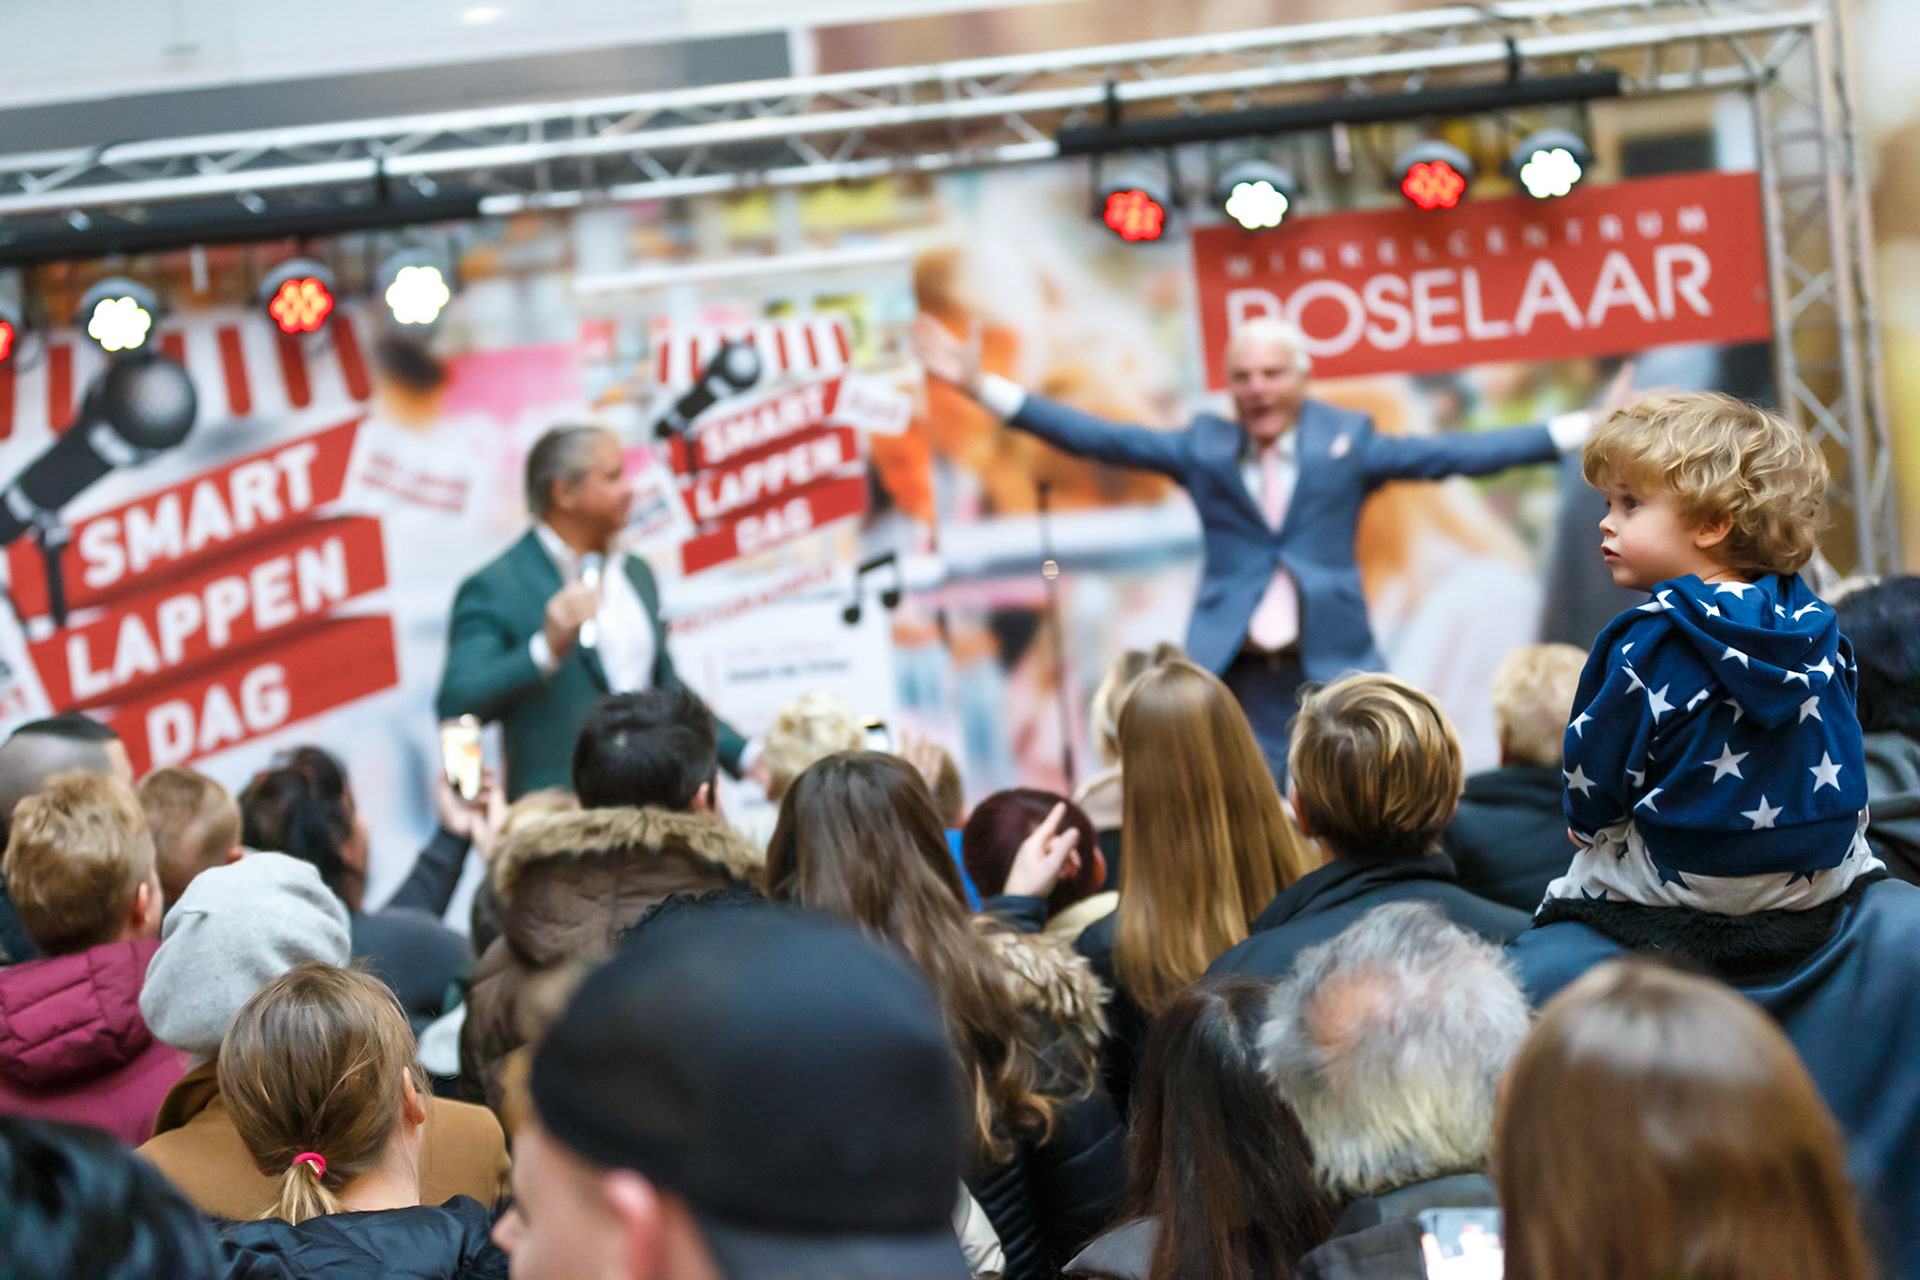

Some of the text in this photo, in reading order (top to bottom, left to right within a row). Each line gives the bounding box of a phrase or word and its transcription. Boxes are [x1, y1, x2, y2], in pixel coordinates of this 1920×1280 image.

[703, 382, 825, 464] SMART
[79, 442, 318, 588] SMART
[695, 432, 843, 519] LAPPEN
[735, 496, 814, 557] DAG
[65, 536, 350, 701] LAPPEN
[145, 662, 291, 768] DAG
